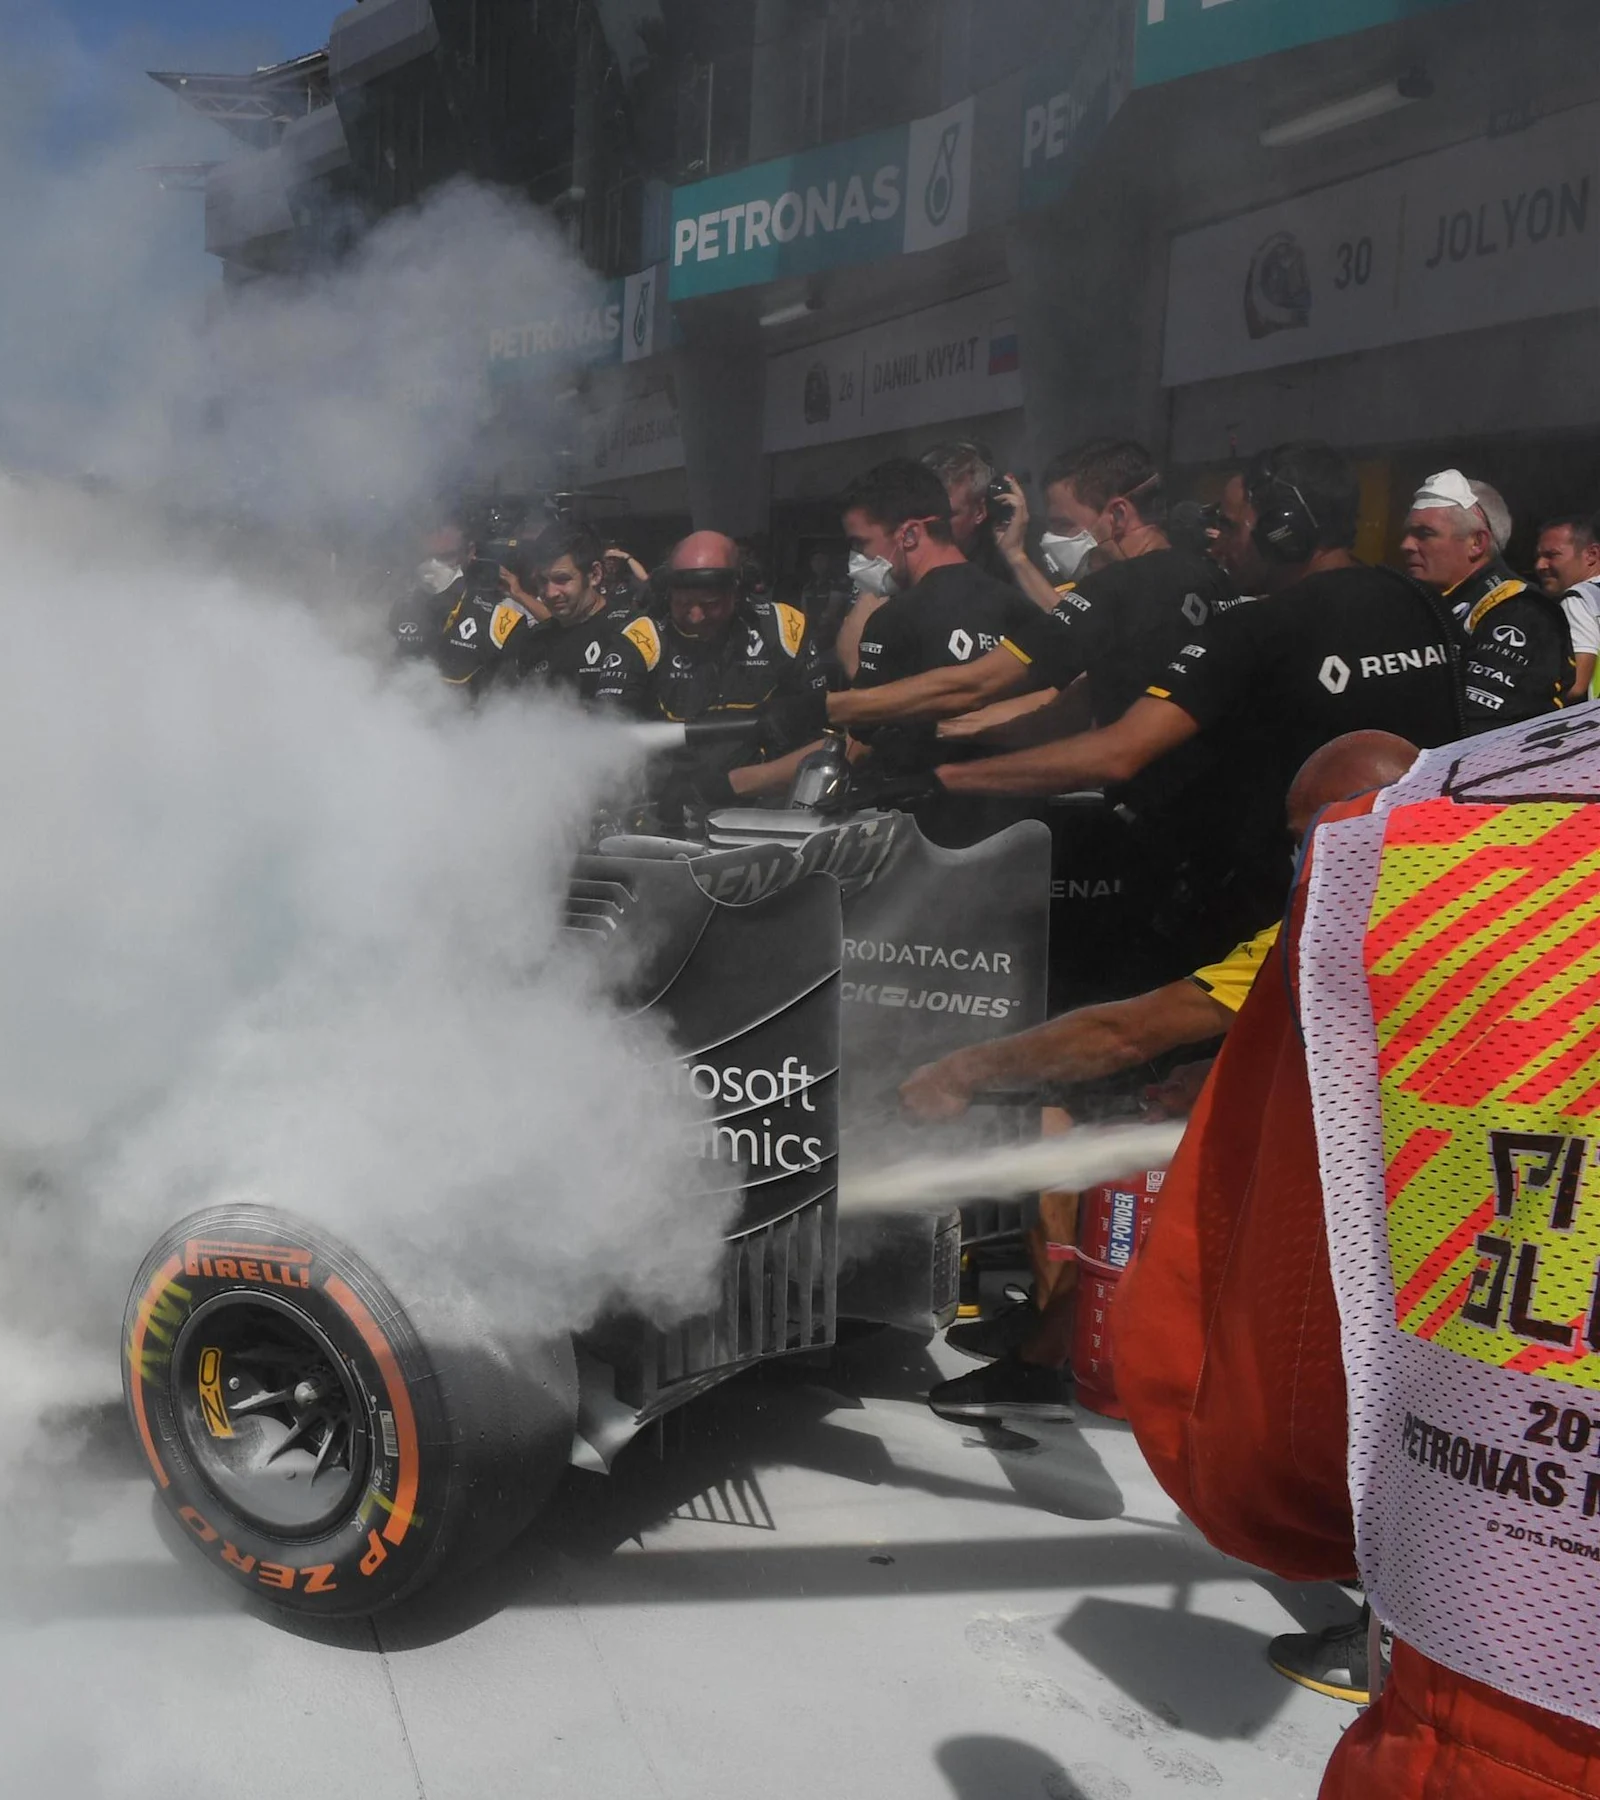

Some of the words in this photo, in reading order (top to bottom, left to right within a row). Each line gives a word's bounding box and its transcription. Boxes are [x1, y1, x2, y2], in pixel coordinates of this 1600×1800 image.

[673, 164, 900, 267] PETRONAS
[1333, 236, 1372, 290] 30
[1425, 176, 1590, 269] JOLYON
[489, 304, 620, 363] PETRONAS
[872, 352, 921, 394] DANIIL
[926, 335, 980, 382] KVYAT
[449, 638, 478, 650] RENAULT
[1476, 643, 1529, 667] INFINITI
[1466, 660, 1515, 688] TOTAL
[842, 937, 1013, 975] RODATACAR
[1112, 1192, 1134, 1242] POWDER
[184, 1239, 312, 1289] PIRELLI
[1110, 1242, 1130, 1267] ABC
[1402, 1411, 1566, 1507] PETRONAS
[179, 1506, 338, 1593] ZERO
